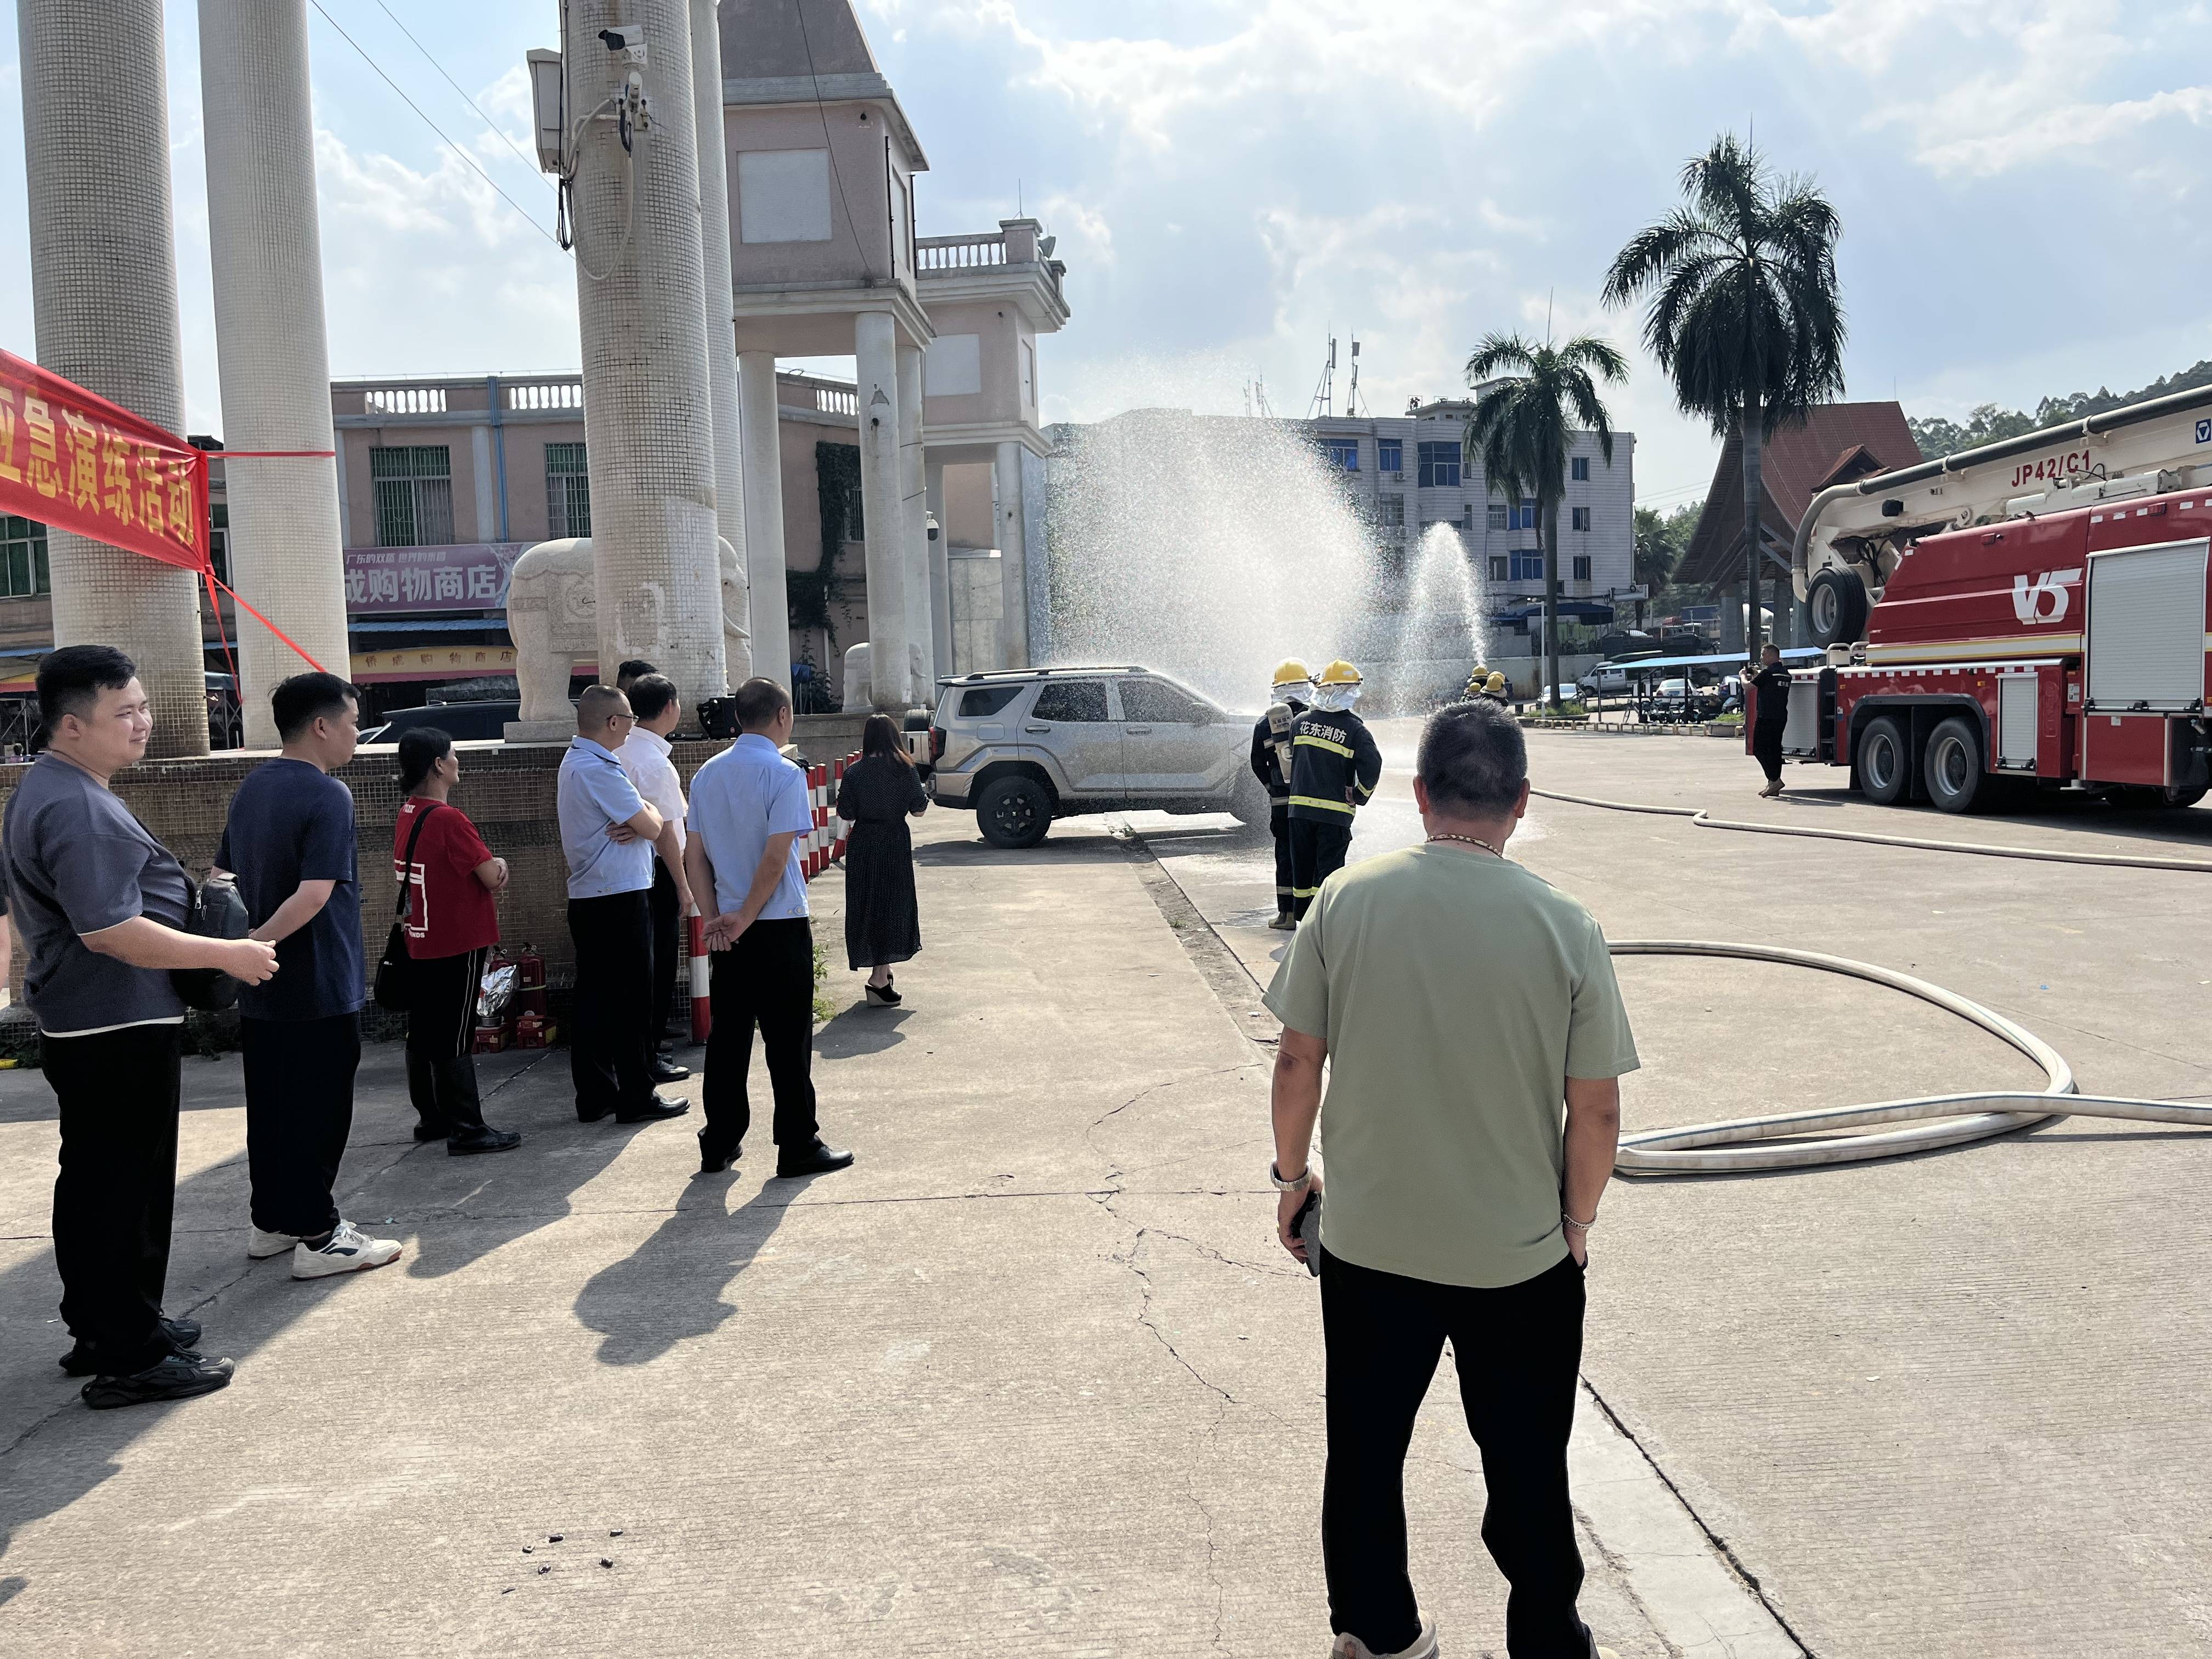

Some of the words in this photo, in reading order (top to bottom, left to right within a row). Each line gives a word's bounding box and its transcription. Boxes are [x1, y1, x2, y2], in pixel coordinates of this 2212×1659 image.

[2012, 449, 2090, 487] JP42/C1
[2012, 568, 2083, 625] V5
[1300, 720, 1347, 744] 花东消防
